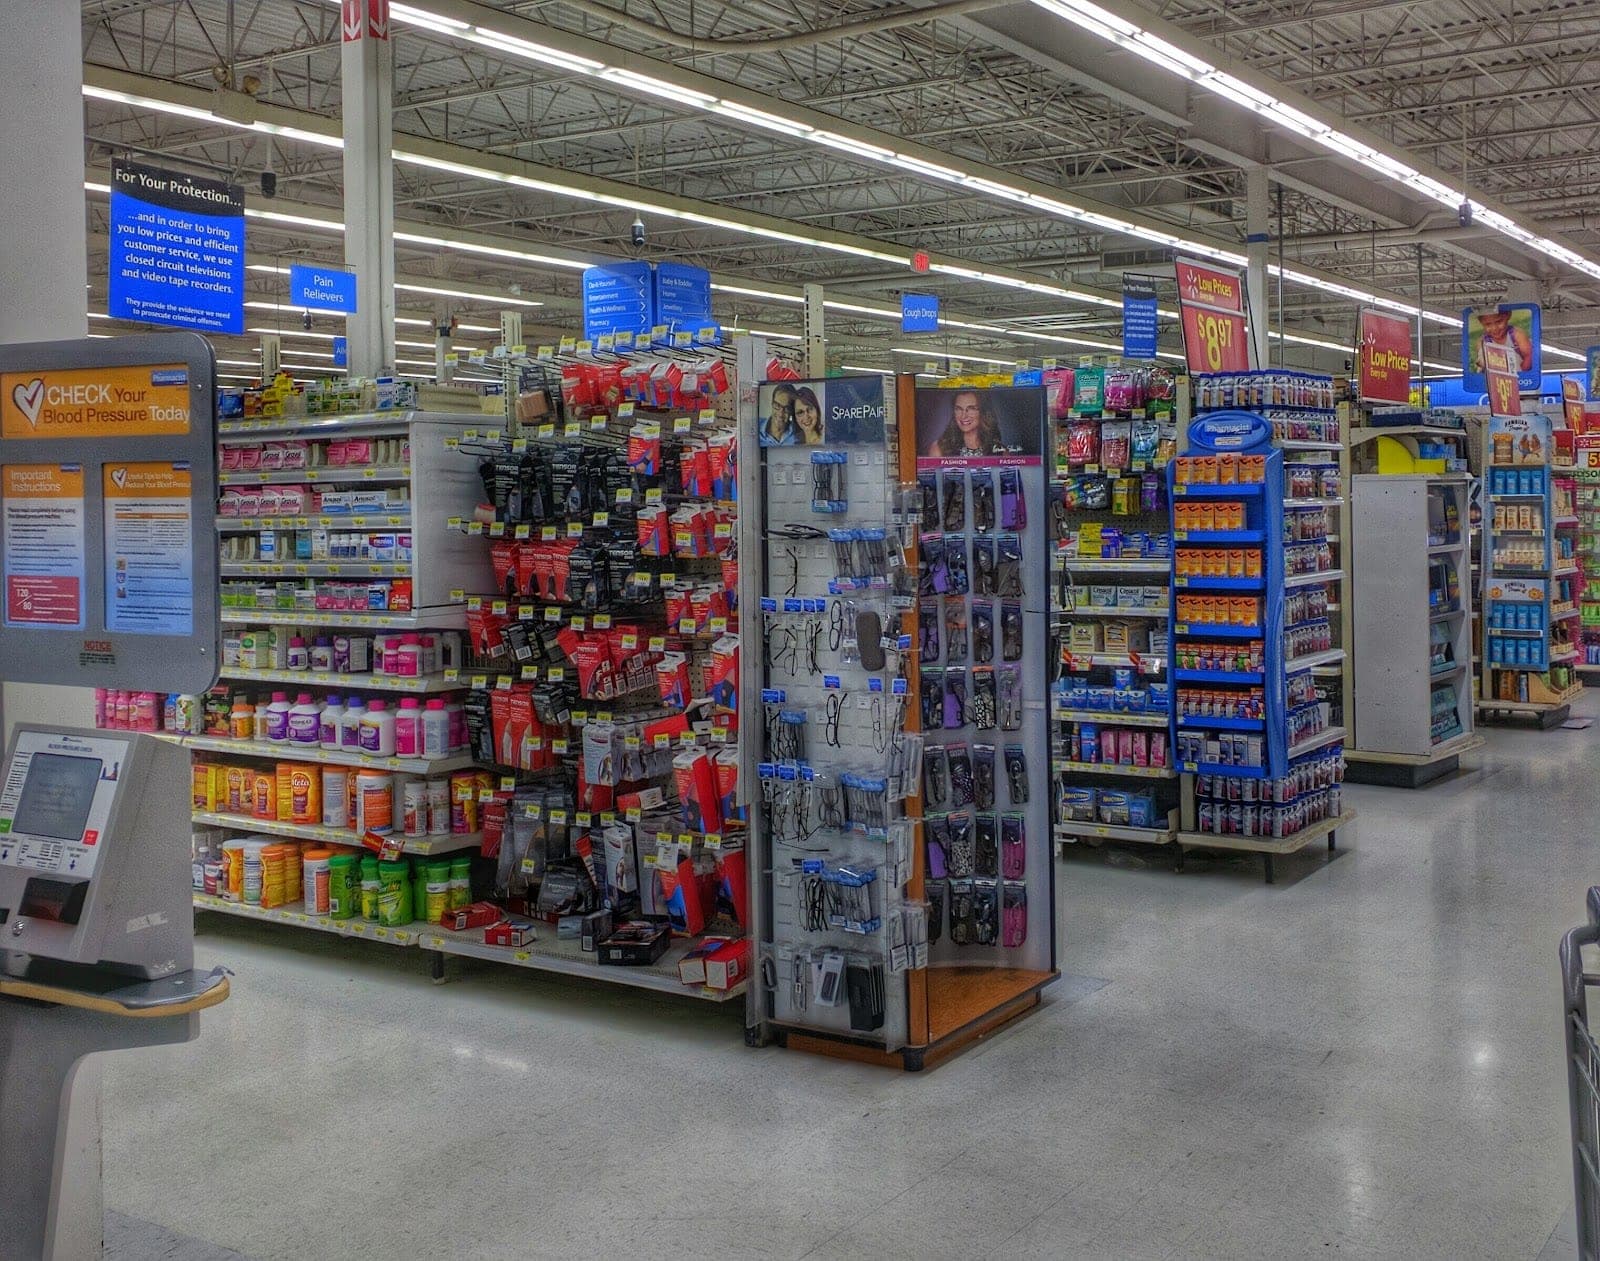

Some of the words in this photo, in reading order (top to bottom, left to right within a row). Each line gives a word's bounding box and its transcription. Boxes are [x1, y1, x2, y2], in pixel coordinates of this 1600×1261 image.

[115, 168, 136, 182] For
[139, 173, 167, 191] Your
[169, 180, 242, 207] Protection...
[128, 212, 155, 223] ...and
[157, 216, 166, 225] in
[168, 218, 193, 231] order
[195, 221, 205, 232] to
[206, 223, 230, 239] bring
[117, 223, 135, 234] you
[137, 223, 154, 237] low
[156, 230, 183, 243] prices
[184, 234, 201, 246] and
[203, 238, 239, 254] efficient
[124, 239, 166, 254] customer
[168, 246, 201, 261] service,
[203, 252, 216, 263] we
[218, 255, 233, 266] use
[125, 253, 154, 266] closed
[156, 258, 184, 272] circuit
[186, 263, 231, 280] televisions
[121, 268, 139, 279] and
[141, 270, 167, 283] video
[169, 275, 189, 288] tape
[190, 280, 234, 294] recorders.
[313, 275, 334, 288] Pain
[1198, 274, 1212, 292] Low
[1212, 277, 1232, 299] Prices
[303, 287, 344, 303] Relievers
[662, 290, 677, 298] Home
[125, 297, 141, 307] They
[141, 299, 165, 310] provide
[166, 303, 177, 311] the
[178, 305, 204, 315] evidence
[215, 311, 231, 319] need
[141, 309, 172, 320] prosecute
[172, 312, 197, 323] criminal
[589, 306, 604, 314] Health
[904, 307, 921, 320] Cough
[921, 308, 937, 320] Drops
[1371, 347, 1386, 367] Low
[1387, 349, 1409, 371] Prices
[47, 383, 113, 406] CHECK
[114, 388, 147, 404] Your
[43, 409, 83, 425] Blood
[86, 408, 148, 423] Pressure
[149, 405, 191, 424] Today
[999, 458, 1026, 466] FASHION
[11, 469, 53, 482] Important
[11, 481, 62, 493] Instructions
[144, 481, 156, 489] Your
[156, 481, 172, 489] Blood
[16, 588, 29, 597] 120
